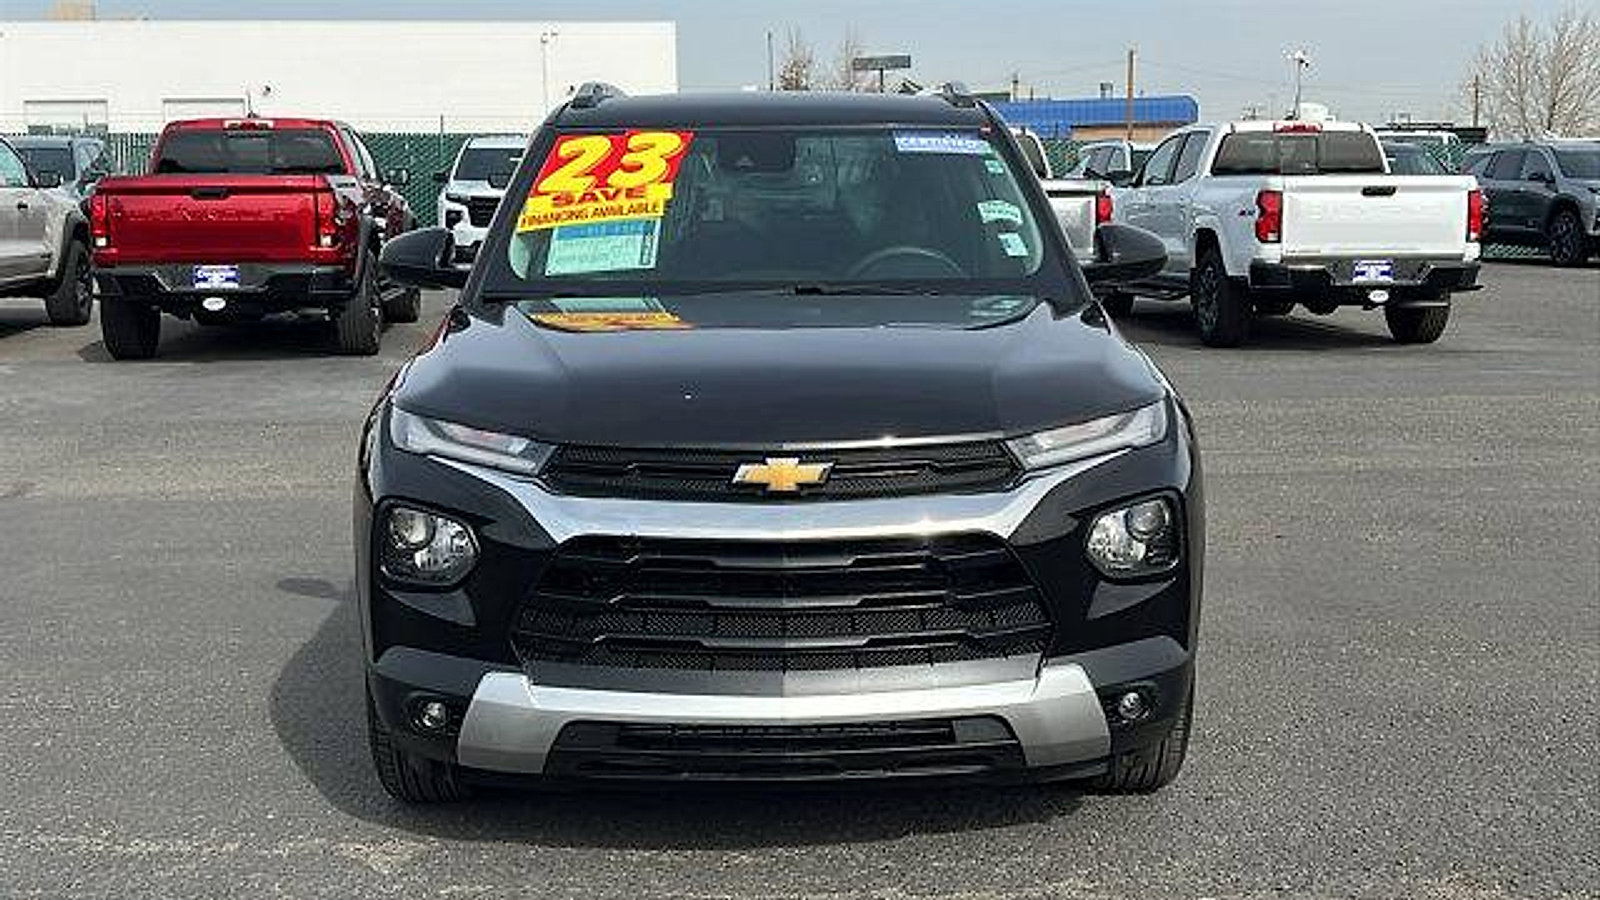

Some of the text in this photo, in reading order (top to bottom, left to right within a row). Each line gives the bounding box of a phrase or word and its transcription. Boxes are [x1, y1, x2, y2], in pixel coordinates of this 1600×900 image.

[538, 132, 683, 193] 23
[551, 185, 648, 208] SAVE
[520, 202, 660, 227] FINANCING AVAILABLE
